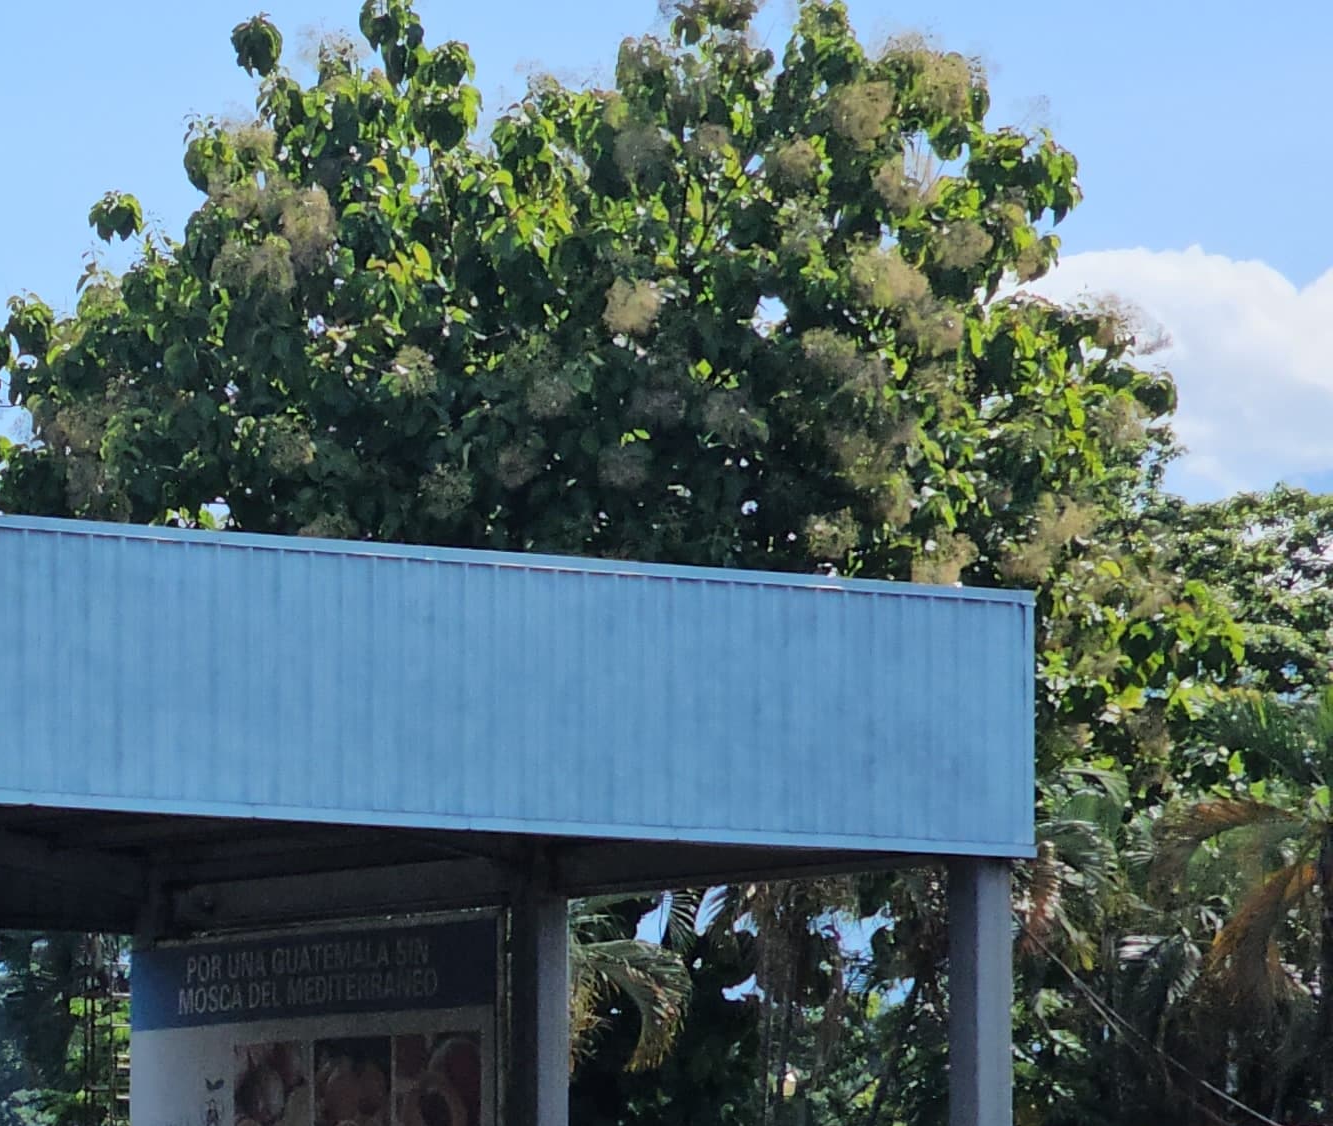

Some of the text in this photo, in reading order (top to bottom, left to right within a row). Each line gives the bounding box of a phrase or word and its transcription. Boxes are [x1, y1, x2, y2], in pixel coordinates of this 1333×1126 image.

[186, 937, 430, 984] POR UNA GUATEMALA SIN
[178, 967, 438, 1015] MOSCA DEL MEDITERRANEO
